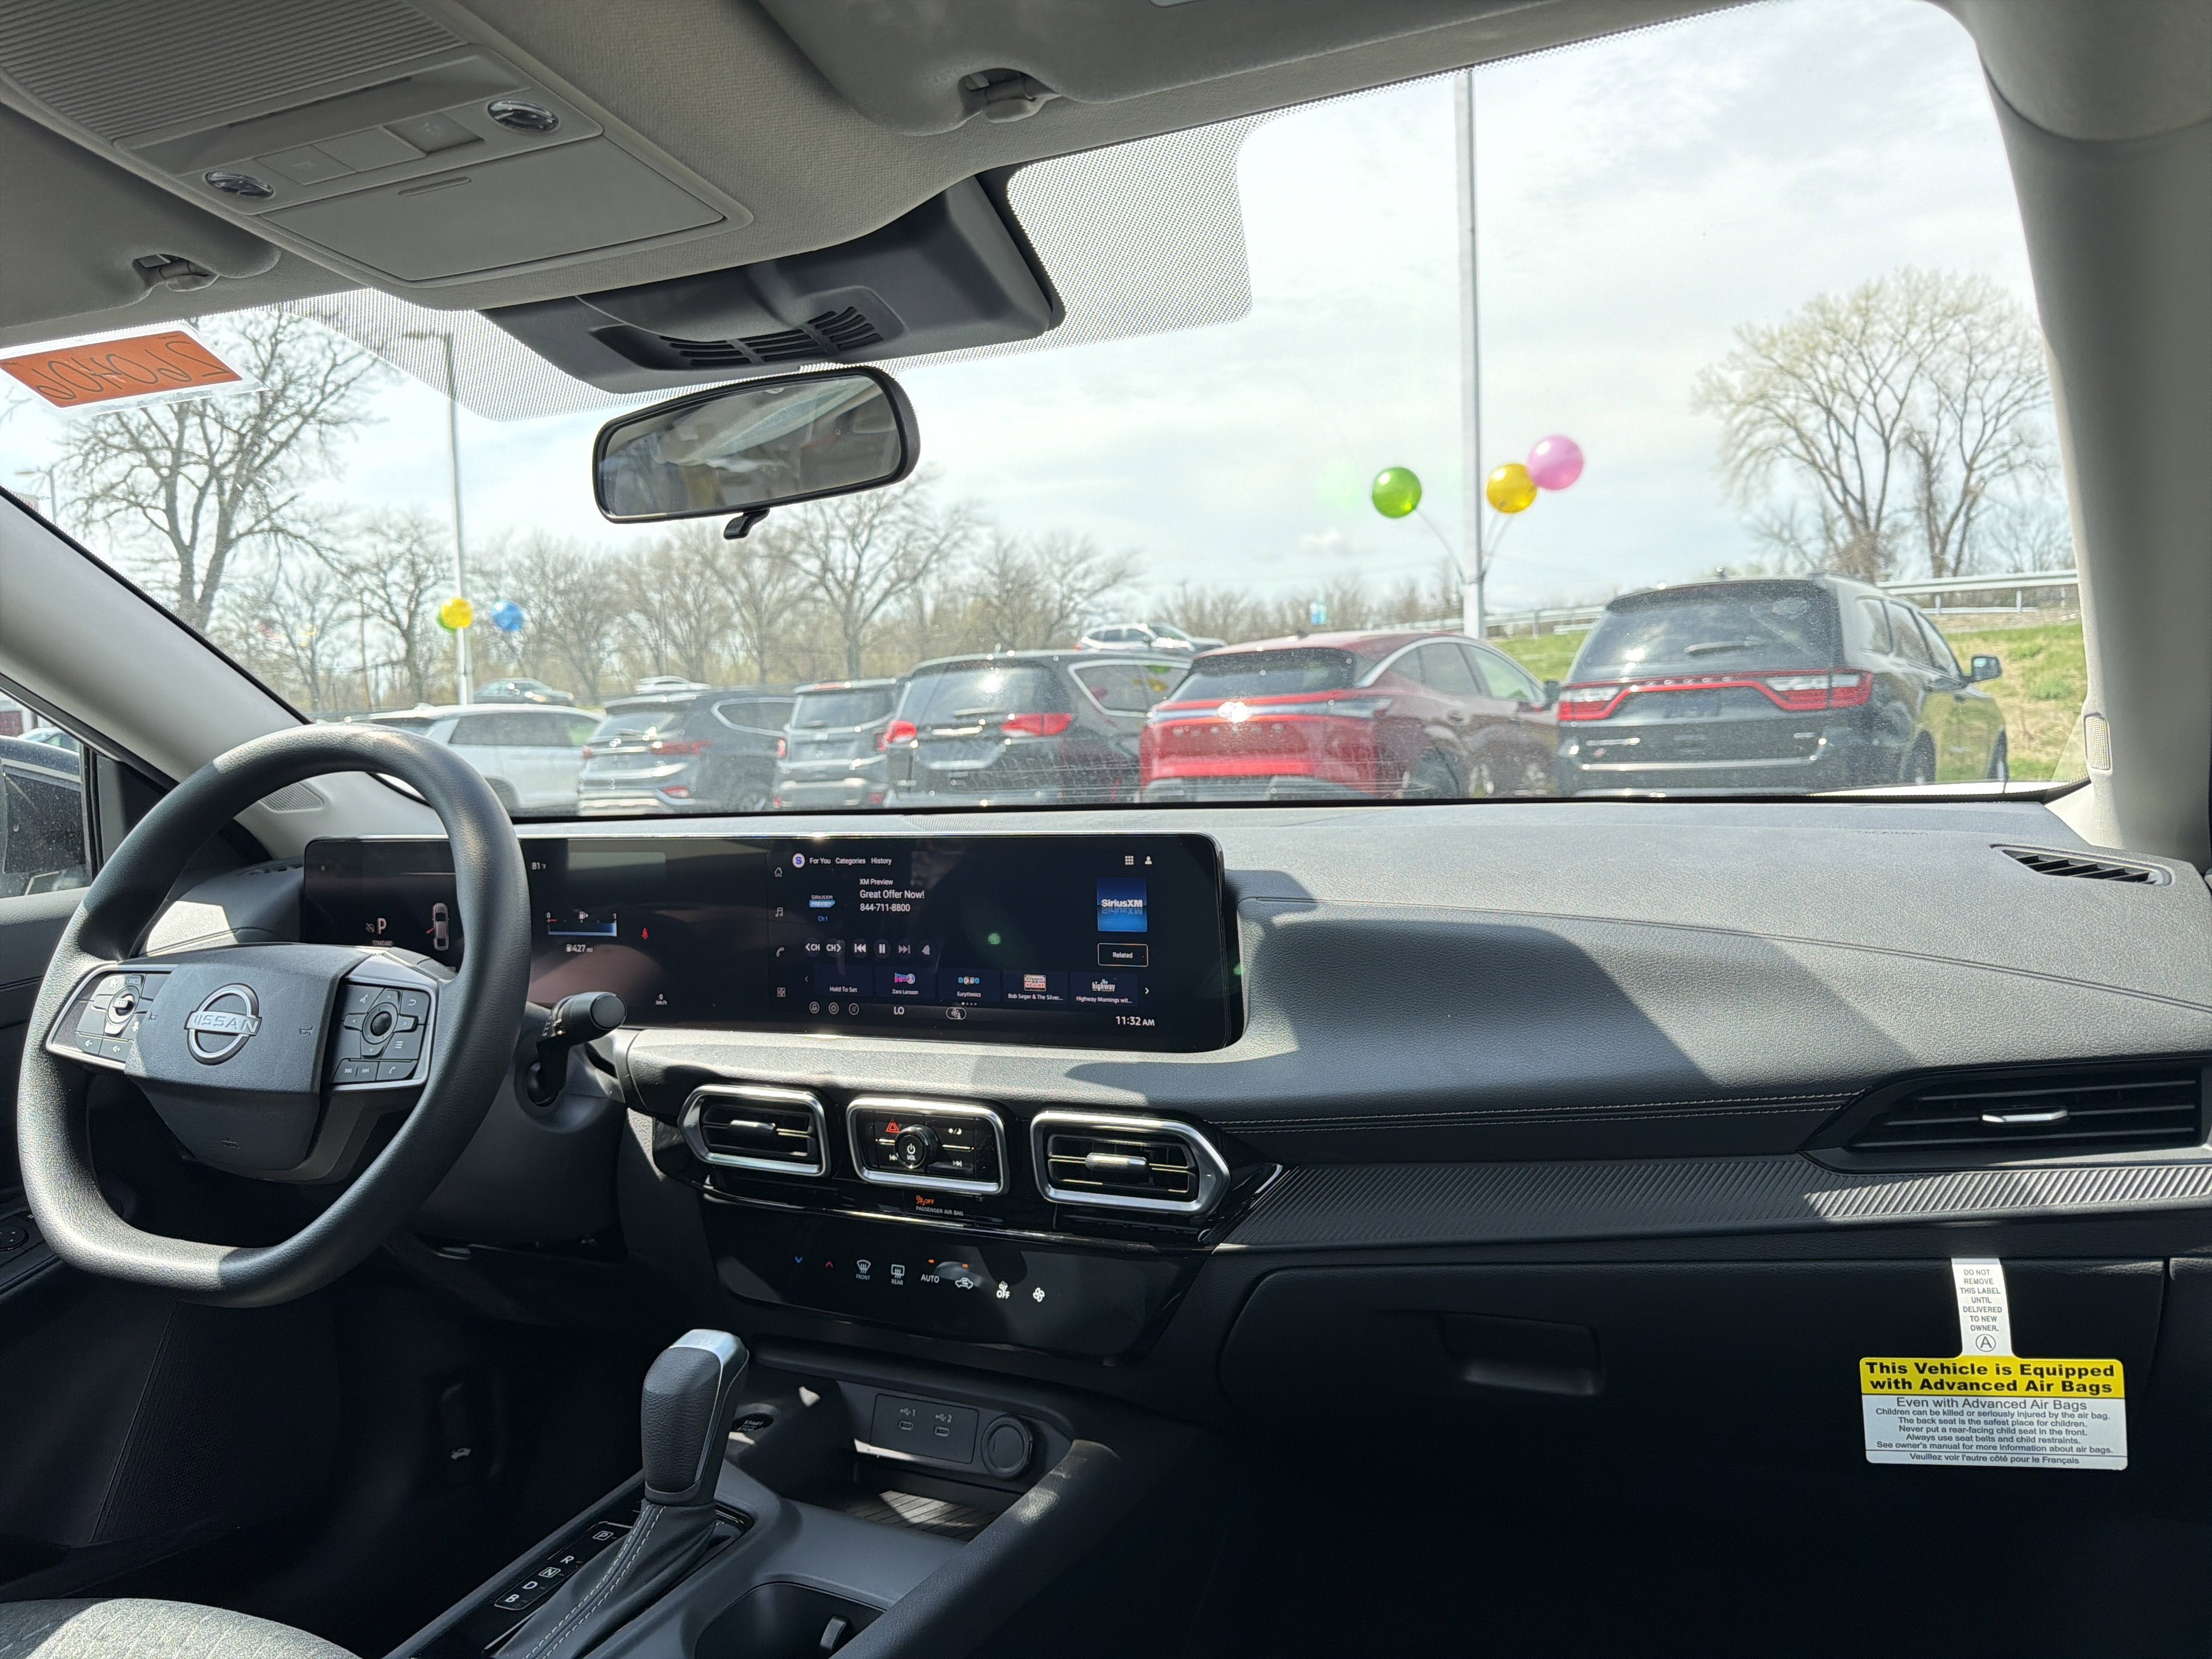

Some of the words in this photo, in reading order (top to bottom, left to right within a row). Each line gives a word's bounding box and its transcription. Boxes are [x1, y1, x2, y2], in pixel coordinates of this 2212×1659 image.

[836, 857, 866, 866] Categories
[871, 857, 892, 866] History
[860, 890, 881, 899] Great
[883, 890, 903, 899] Offer
[905, 890, 925, 899] Now!
[860, 903, 911, 912] 844-711-8800
[1102, 899, 1143, 907] SiriusXM
[377, 917, 387, 934] P
[1092, 982, 1115, 992] highway
[894, 1006, 905, 1015] LO
[192, 1015, 259, 1033] NISSAN
[1116, 1016, 1141, 1026] 11:32
[921, 1274, 939, 1283] AUTO
[996, 1290, 1010, 1299] OFF
[1980, 1336, 1993, 1348] A
[1865, 1362, 1908, 1374] This
[1914, 1362, 1988, 1375] Vehicle
[1995, 1363, 2012, 1375] is
[2020, 1364, 2114, 1379] Equipped
[1870, 1378, 1912, 1390] with
[1920, 1378, 2017, 1391] Advanced
[2025, 1380, 2054, 1392] Air
[2061, 1380, 2112, 1395] Bags
[1897, 1397, 1928, 1407] Even
[1933, 1398, 1958, 1408] with
[1962, 1398, 2026, 1409] Advanced
[2030, 1400, 2049, 1409] Air
[2053, 1400, 2087, 1412] Bags
[947, 1414, 952, 1423] 2
[1977, 1410, 2015, 1418] seriously
[2017, 1410, 2046, 1419] injured
[2091, 1413, 2110, 1421] bag.
[2012, 1419, 2034, 1427] place
[1926, 1426, 1940, 1434] put
[1949, 1426, 1994, 1435] rear-facing
[1906, 1434, 1936, 1442] Always
[2089, 1446, 2113, 1454] bags.
[2042, 1456, 2079, 1465] Français
[560, 1555, 574, 1564] R
[505, 1594, 520, 1602] B
